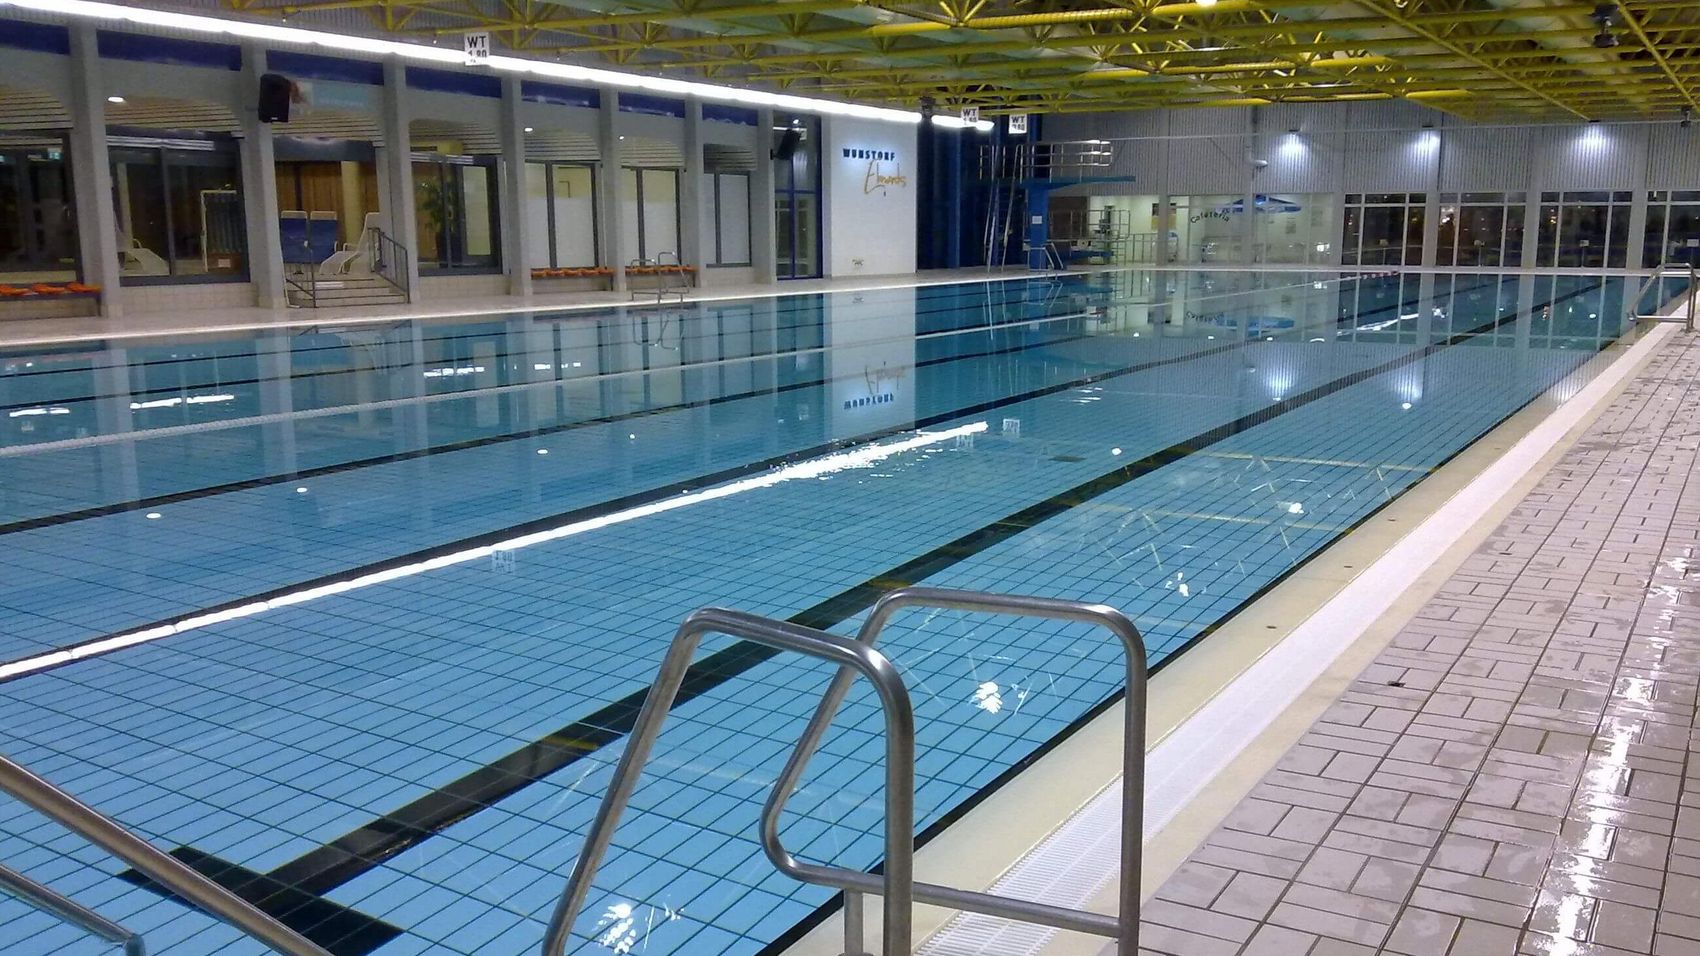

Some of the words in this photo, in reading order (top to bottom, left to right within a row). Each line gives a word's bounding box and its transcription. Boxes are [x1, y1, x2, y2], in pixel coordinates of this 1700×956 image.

[467, 36, 486, 49] WT
[963, 108, 977, 116] WT
[1011, 116, 1025, 124] WT
[843, 148, 895, 161] WUNSTORF
